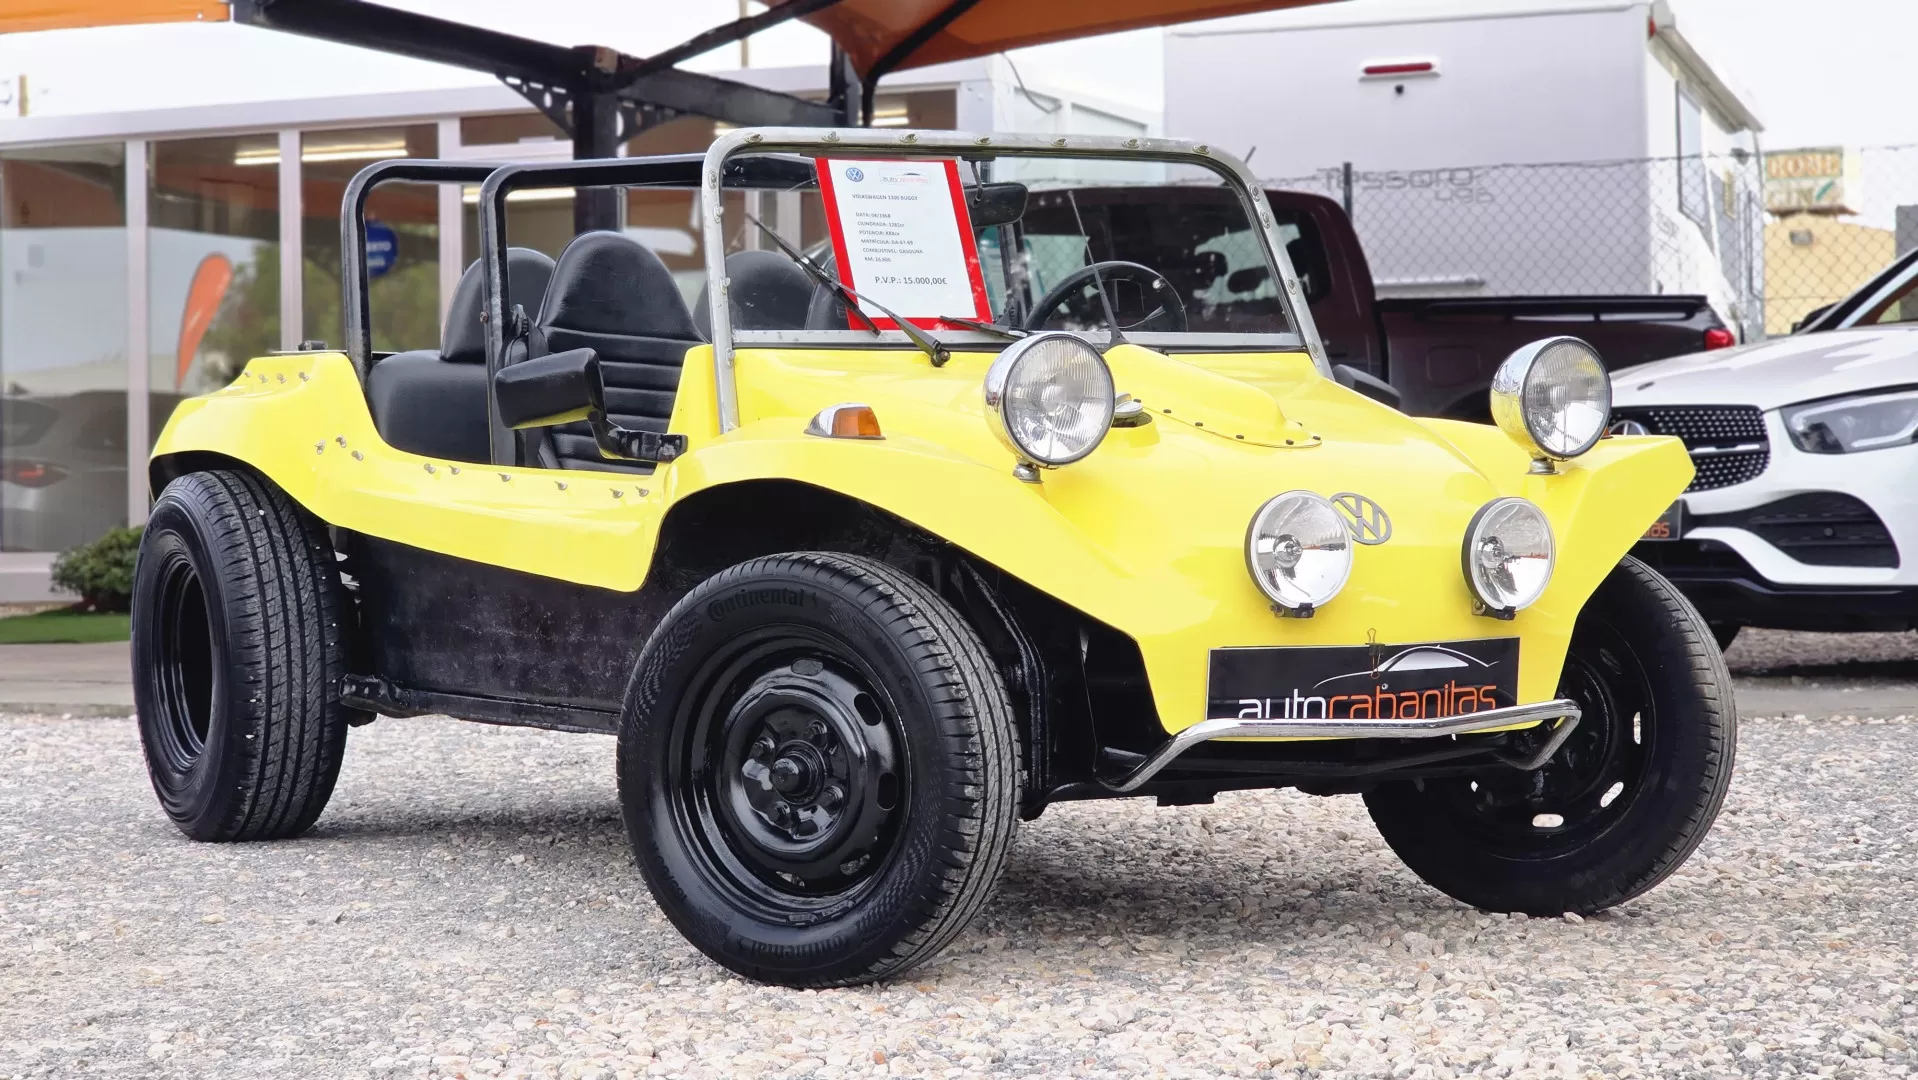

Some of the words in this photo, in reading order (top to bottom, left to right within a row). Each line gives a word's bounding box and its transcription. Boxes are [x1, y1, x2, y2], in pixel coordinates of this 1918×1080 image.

[875, 276, 902, 284] P.V.P.:
[904, 277, 948, 286] 15.000,00€
[707, 588, 805, 623] Continental
[1238, 680, 1497, 719] autocabanitas
